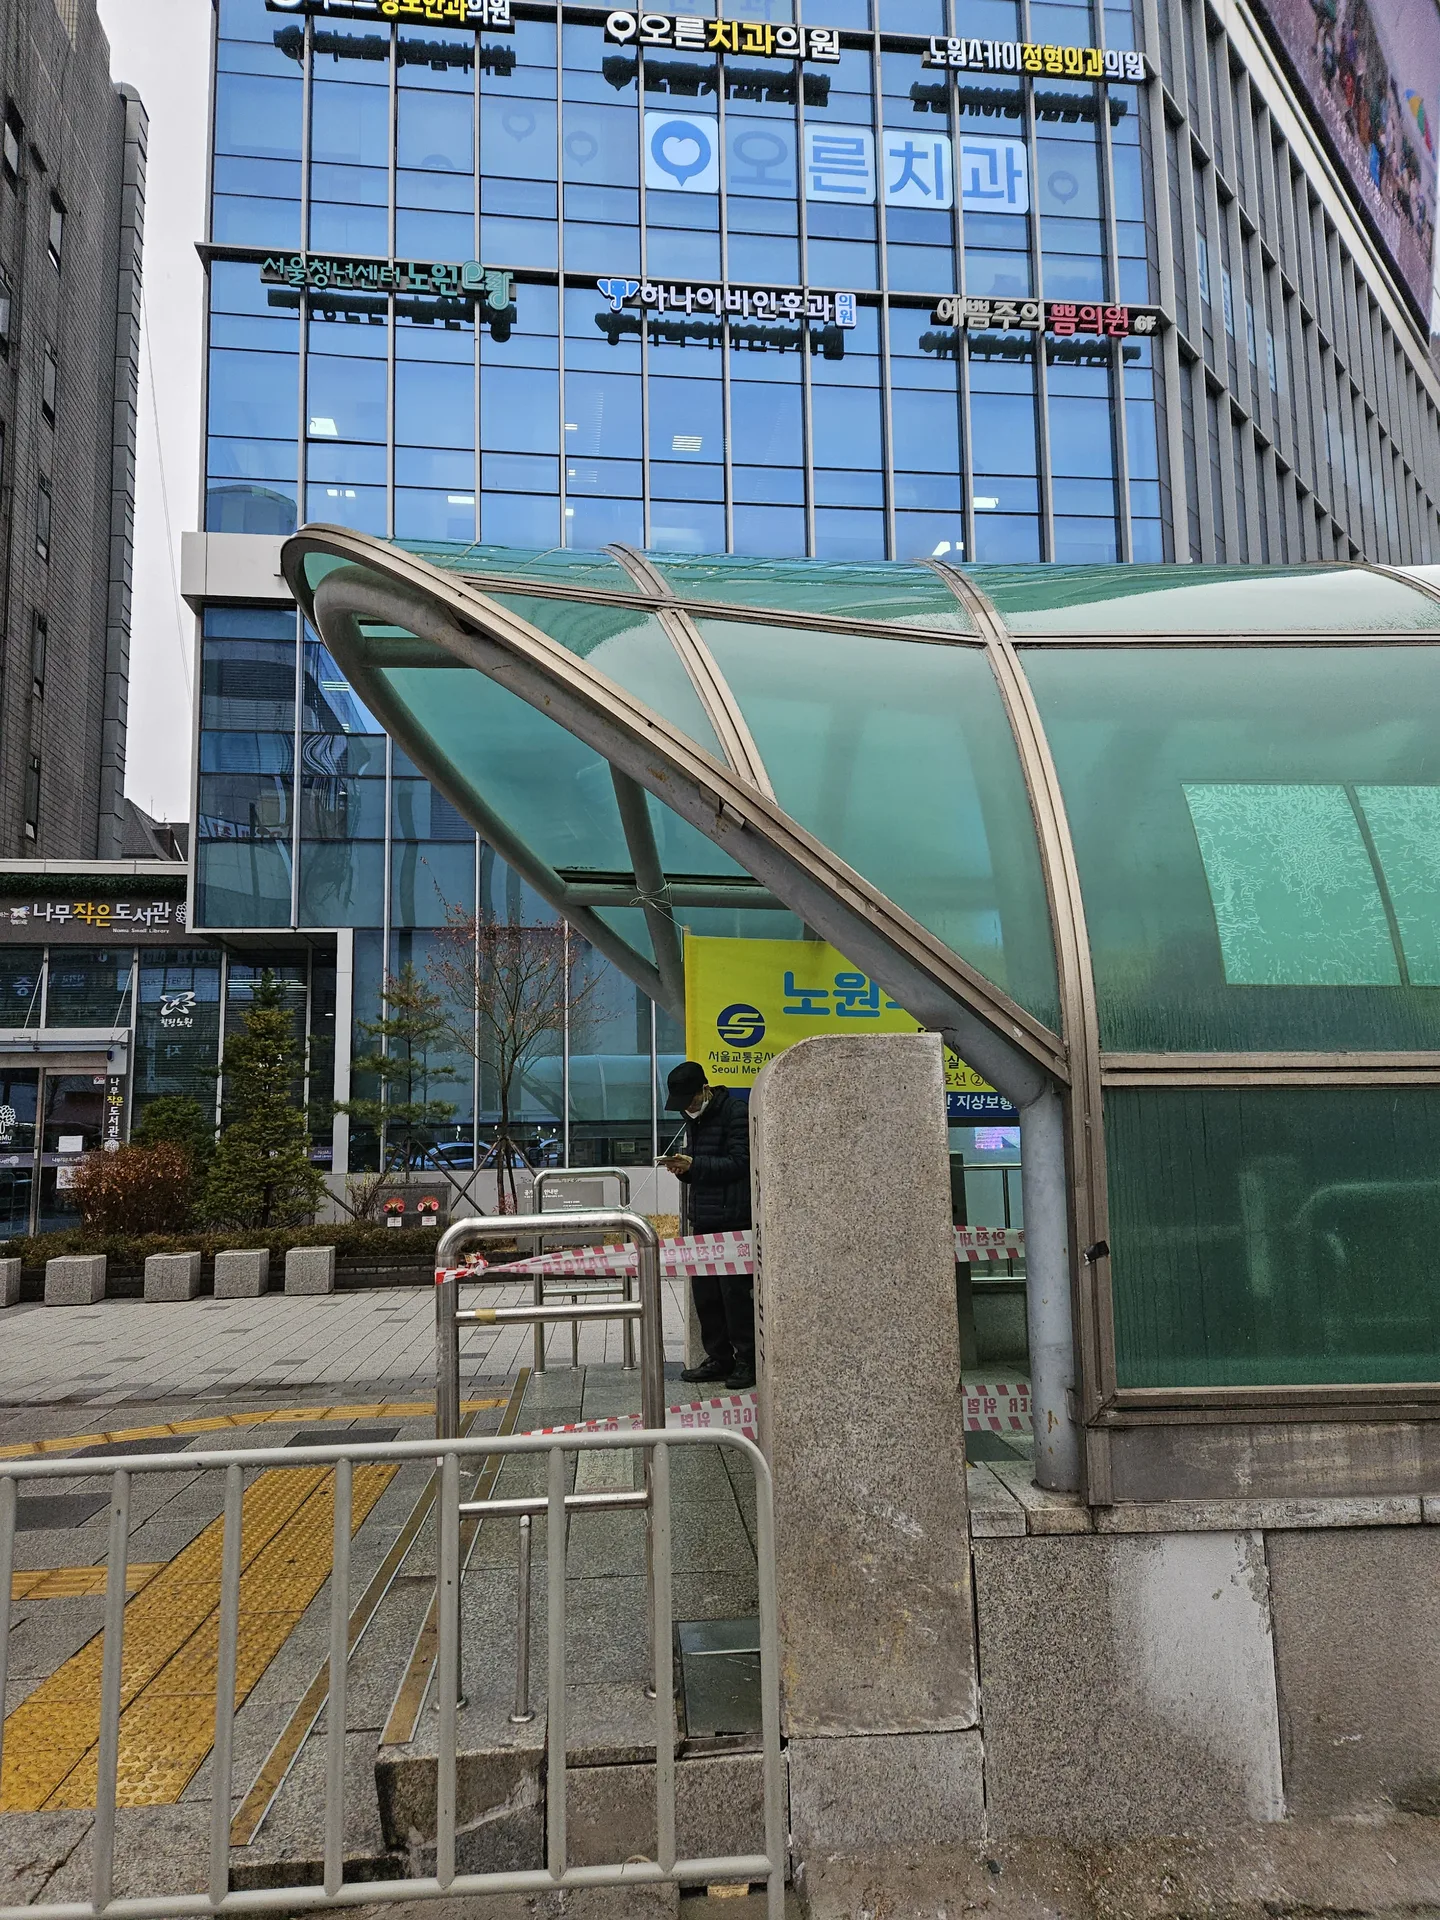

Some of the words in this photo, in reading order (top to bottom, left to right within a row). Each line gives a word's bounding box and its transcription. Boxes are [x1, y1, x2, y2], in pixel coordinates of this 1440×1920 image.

[322, 0, 511, 25] 정보안과의원
[639, 14, 840, 60] 오른치과의원
[930, 36, 1146, 80] 노원스카이정형외과의원
[730, 130, 1023, 204] 오른치과
[261, 256, 400, 290] 서울청년센터
[406, 262, 459, 297] 노원
[783, 971, 903, 1018] 노원
[708, 1050, 776, 1065] 서울교통공사
[712, 1065, 739, 1074] Seoul
[742, 1065, 762, 1074] Met
[956, 1095, 1016, 1110] 지상보행
